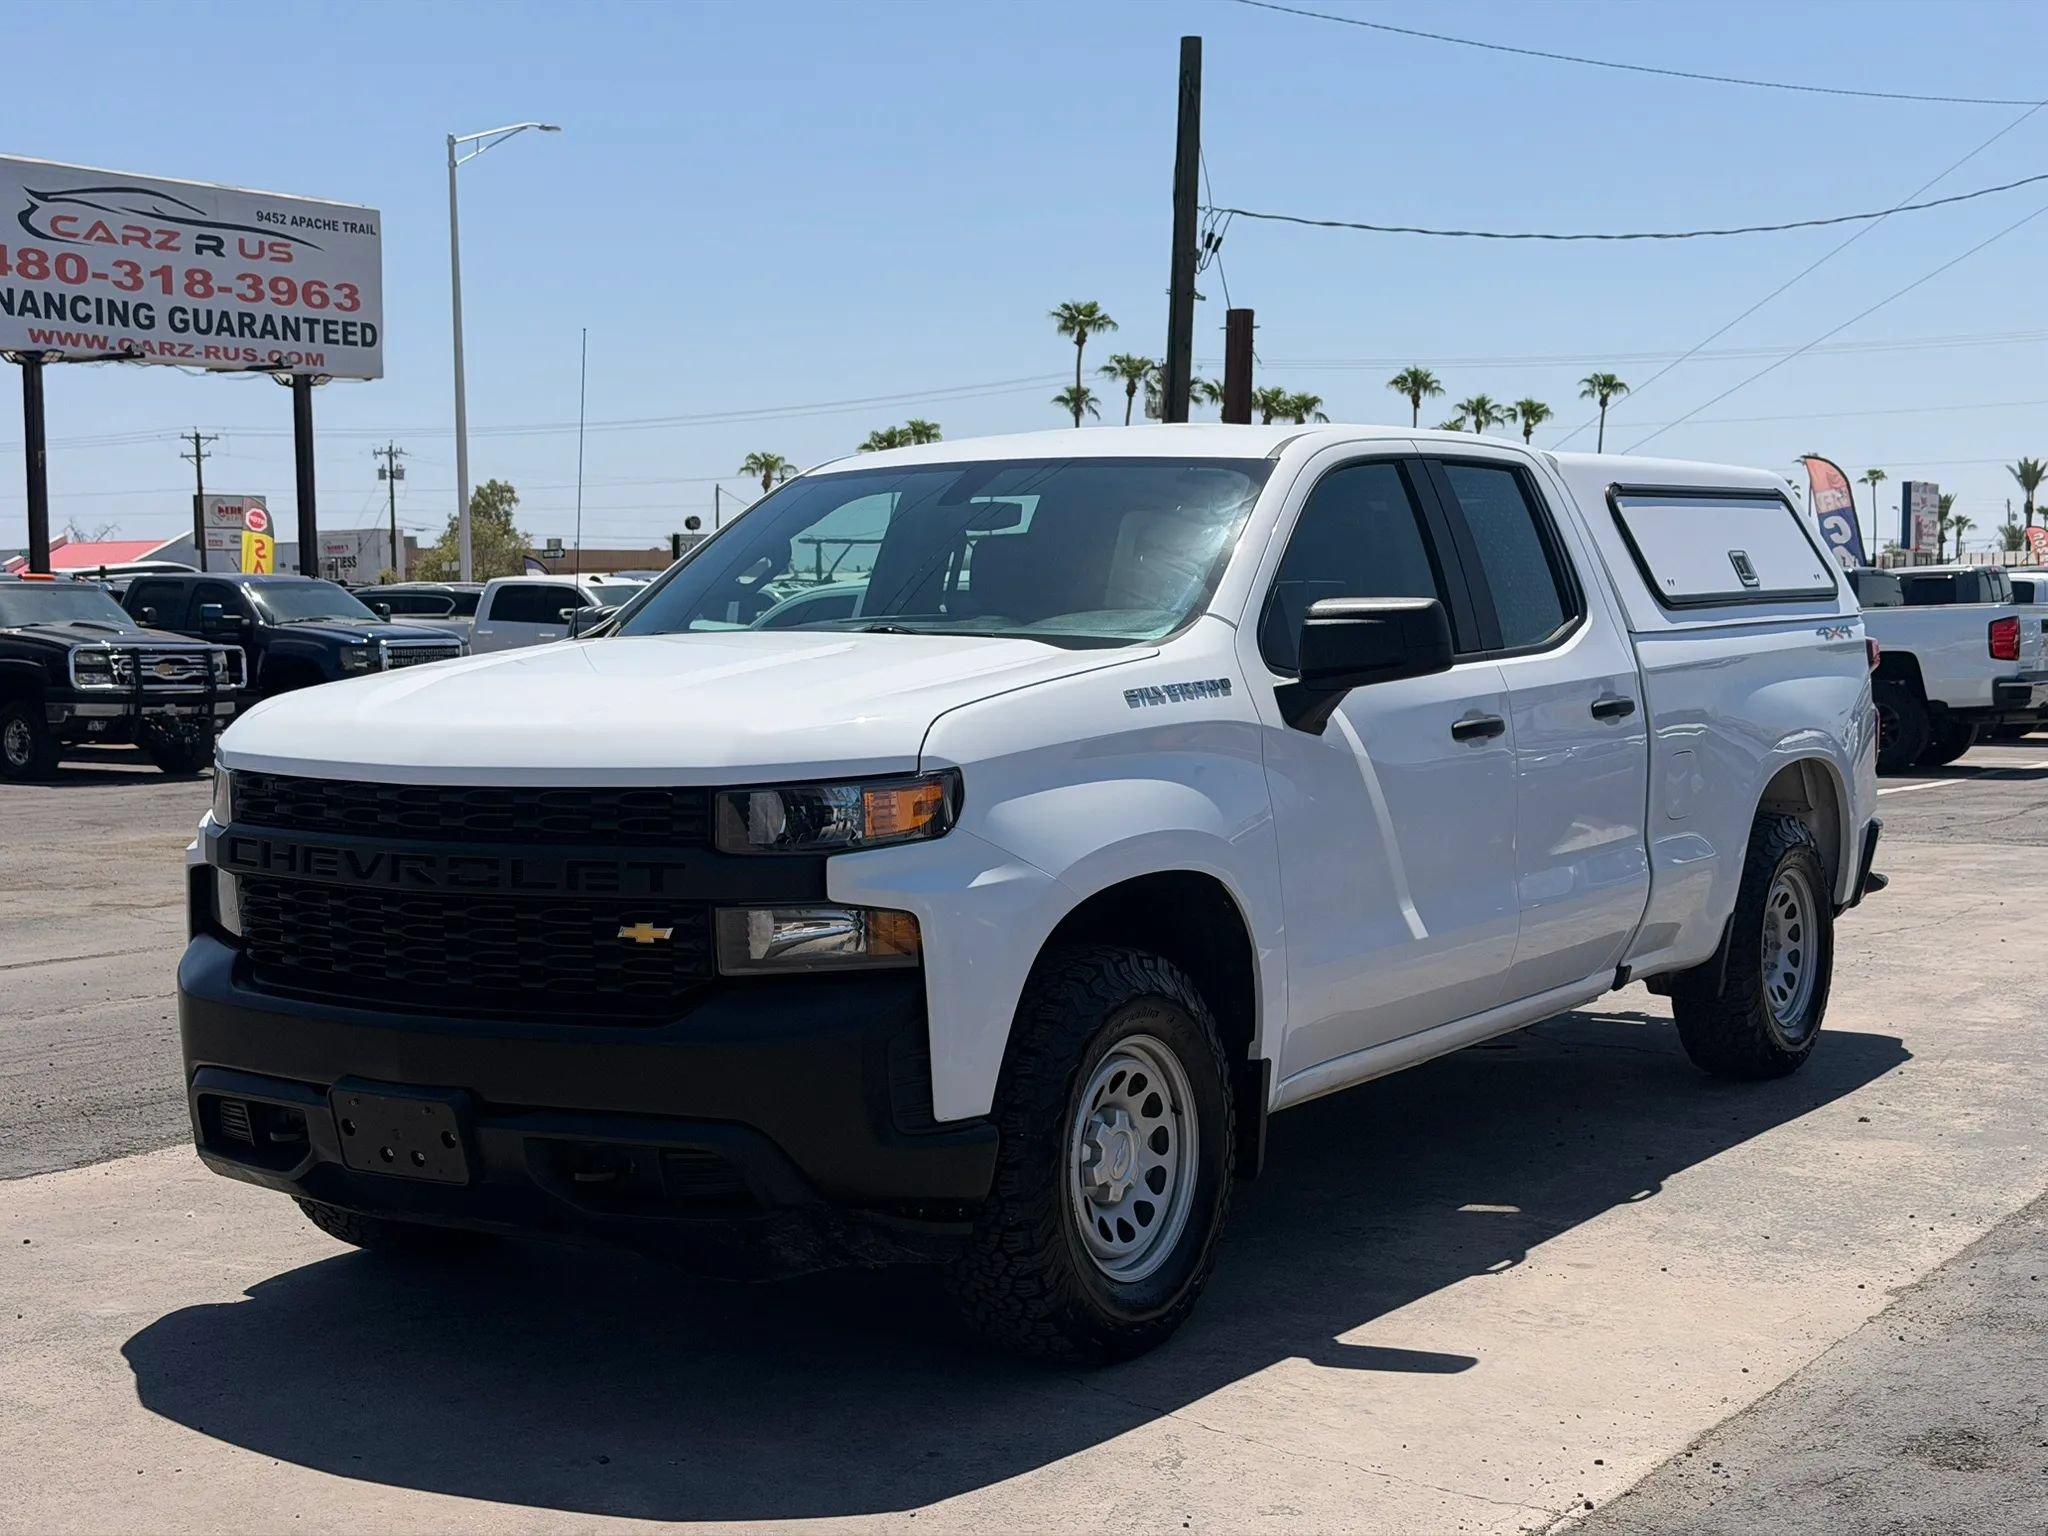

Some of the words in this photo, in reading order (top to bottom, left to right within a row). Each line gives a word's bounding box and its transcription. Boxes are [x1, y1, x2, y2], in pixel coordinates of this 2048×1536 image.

[50, 215, 182, 252] CARZ
[195, 233, 226, 258] R
[238, 237, 294, 264] US
[256, 210, 287, 226] 9452
[290, 215, 339, 232] APACHE
[342, 221, 377, 236] TRAIL
[168, 305, 378, 348] GUARANTEED
[1123, 677, 1232, 705] SILVERADO
[229, 836, 686, 894] CHEVROLET
